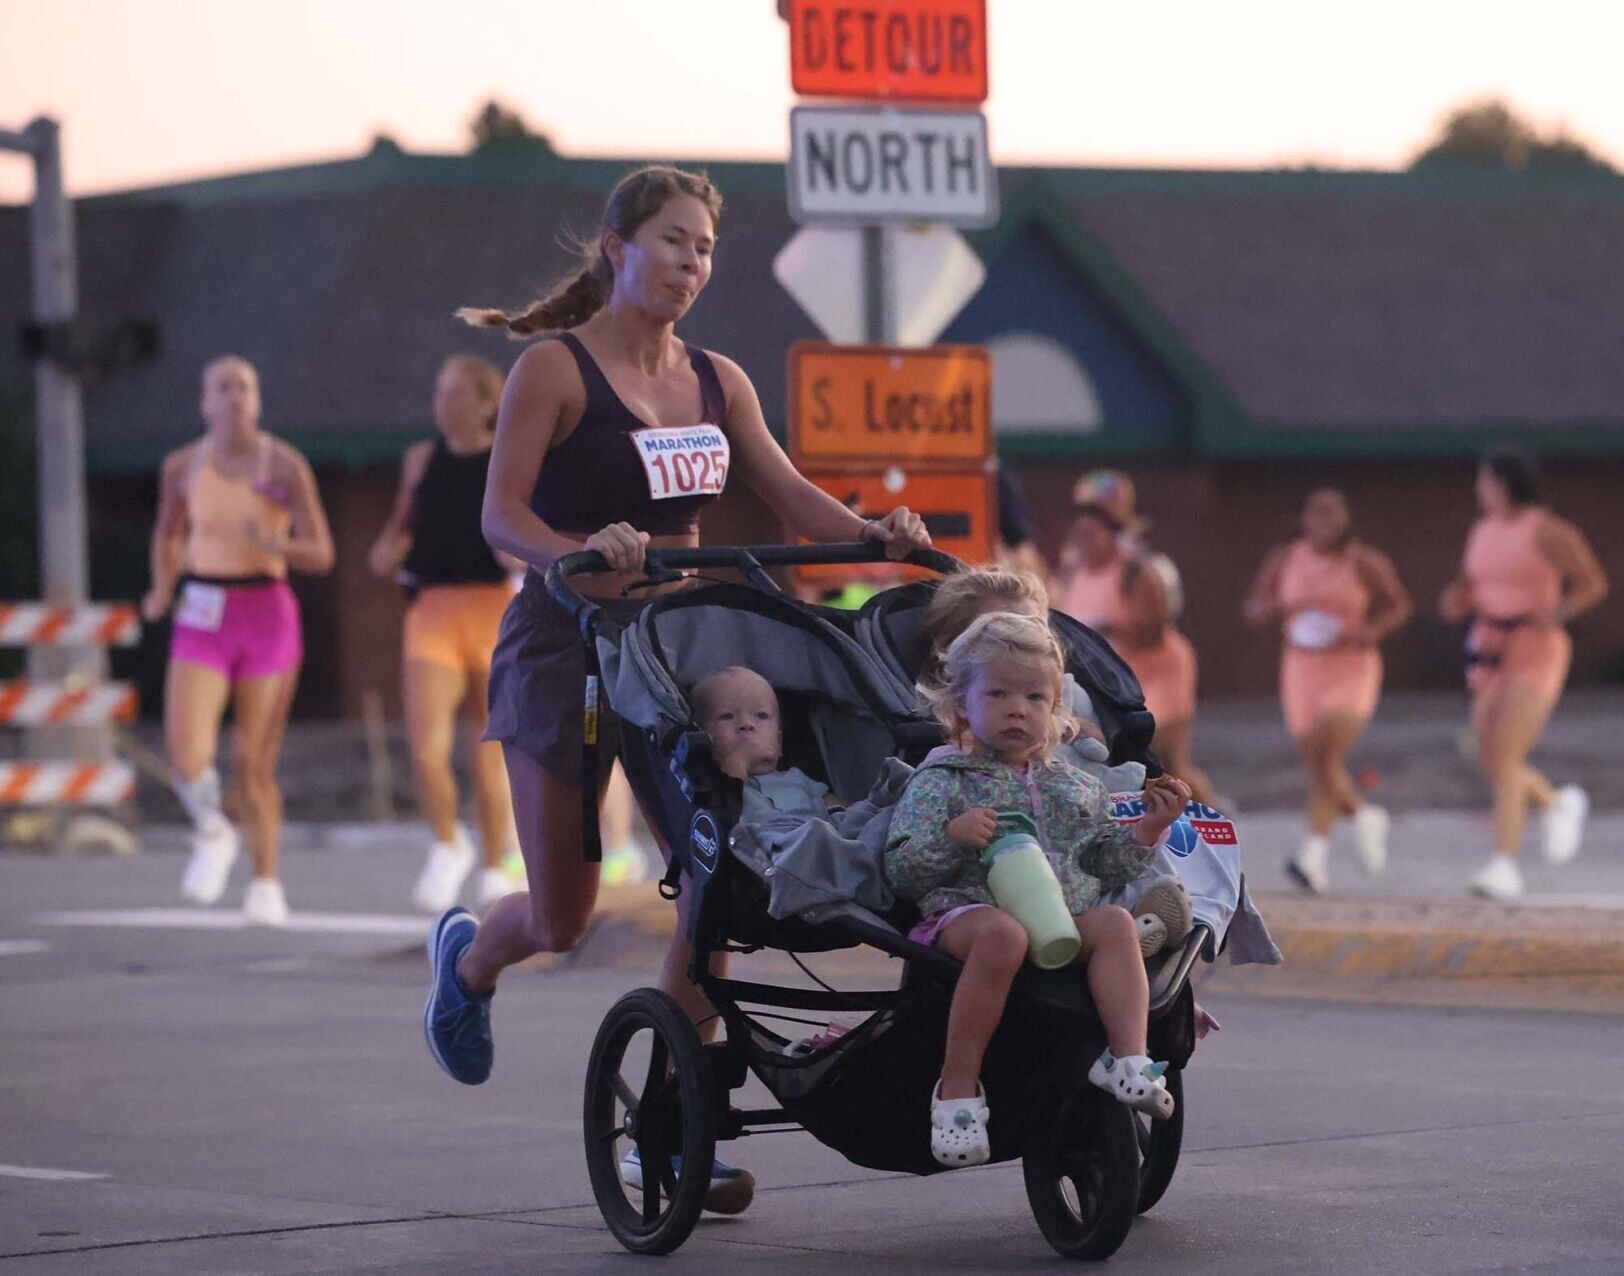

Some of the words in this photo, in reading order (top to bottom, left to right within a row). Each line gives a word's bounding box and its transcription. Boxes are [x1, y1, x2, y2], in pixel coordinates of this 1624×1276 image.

[803, 8, 974, 76] DETOUR
[805, 129, 977, 193] NORTH
[812, 376, 847, 430] S.
[644, 435, 722, 451] MARATHON
[651, 451, 726, 493] 1025
